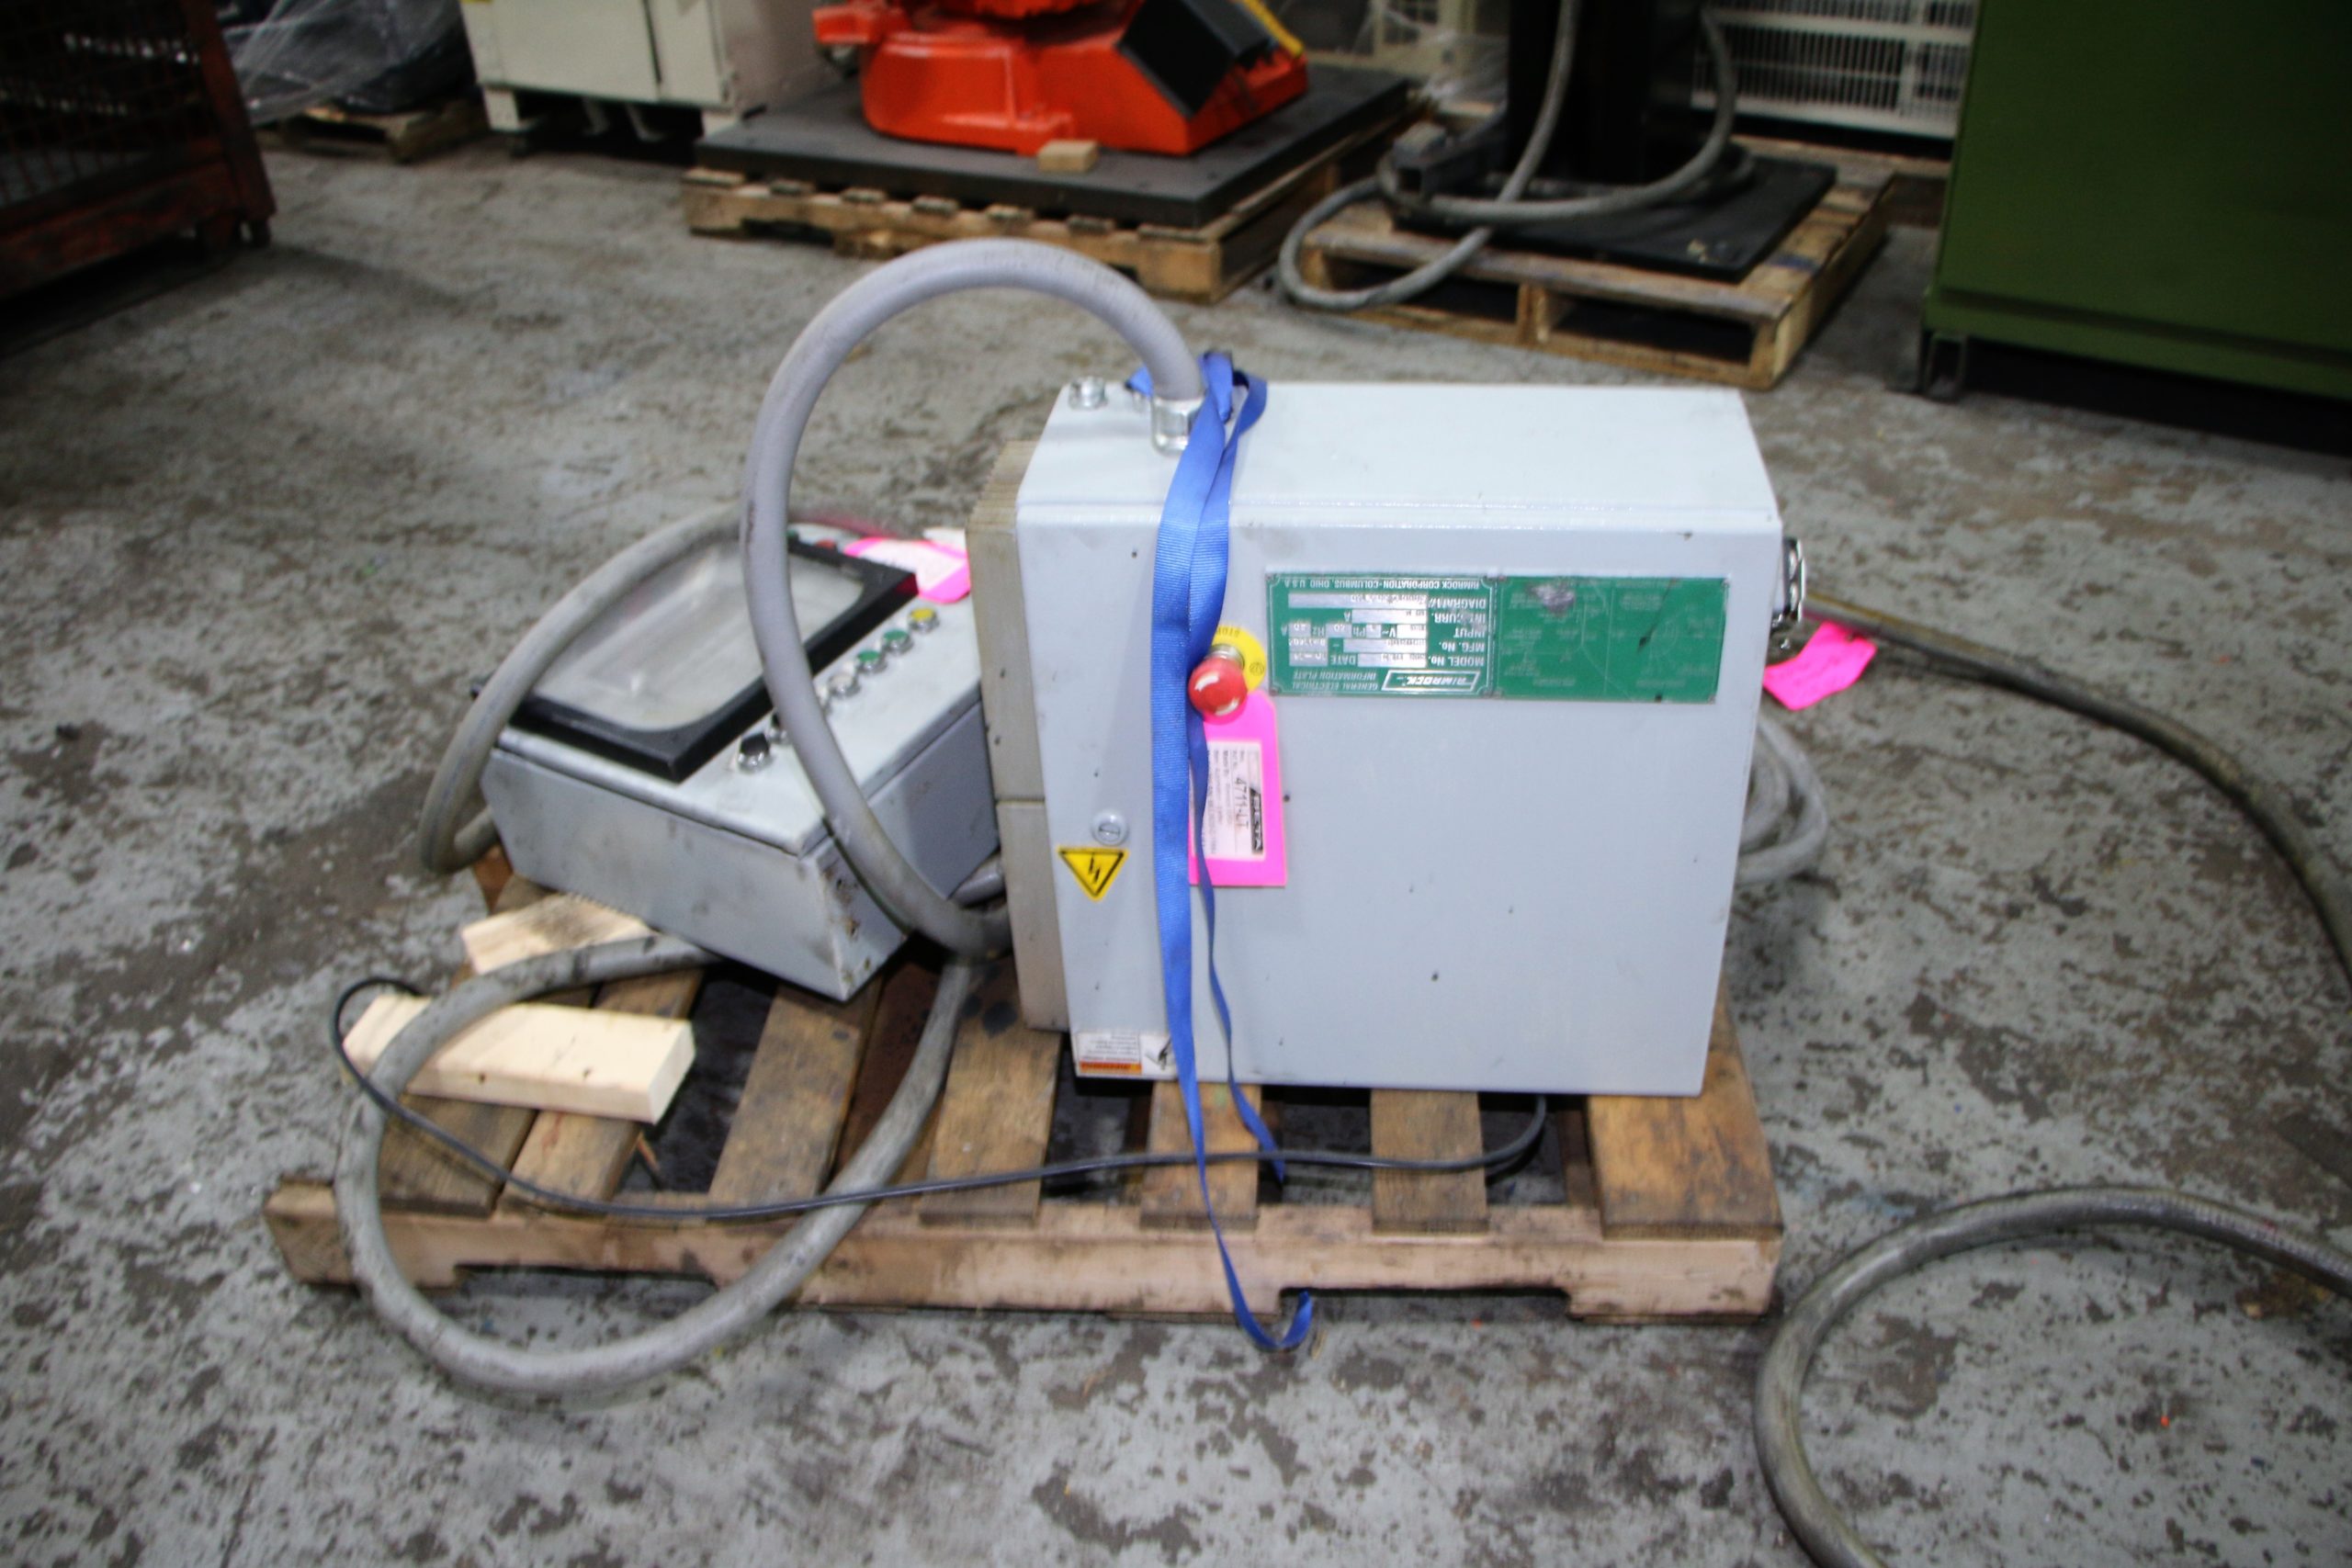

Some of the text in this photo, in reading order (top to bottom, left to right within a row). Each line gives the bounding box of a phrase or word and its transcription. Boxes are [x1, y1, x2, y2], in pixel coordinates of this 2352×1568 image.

[1310, 581, 1329, 589] OHIO
[1442, 581, 1479, 589] RIMROCK
[1453, 627, 1485, 637] INPUT
[1439, 642, 1485, 652] MFG. No.
[1329, 655, 1356, 665] DATE
[1428, 656, 1445, 666] No.
[1448, 656, 1485, 667] MODEL
[1293, 671, 1376, 681] INFORMATION PLATE
[1292, 681, 1378, 691] GENERAL ELECTRICAL
